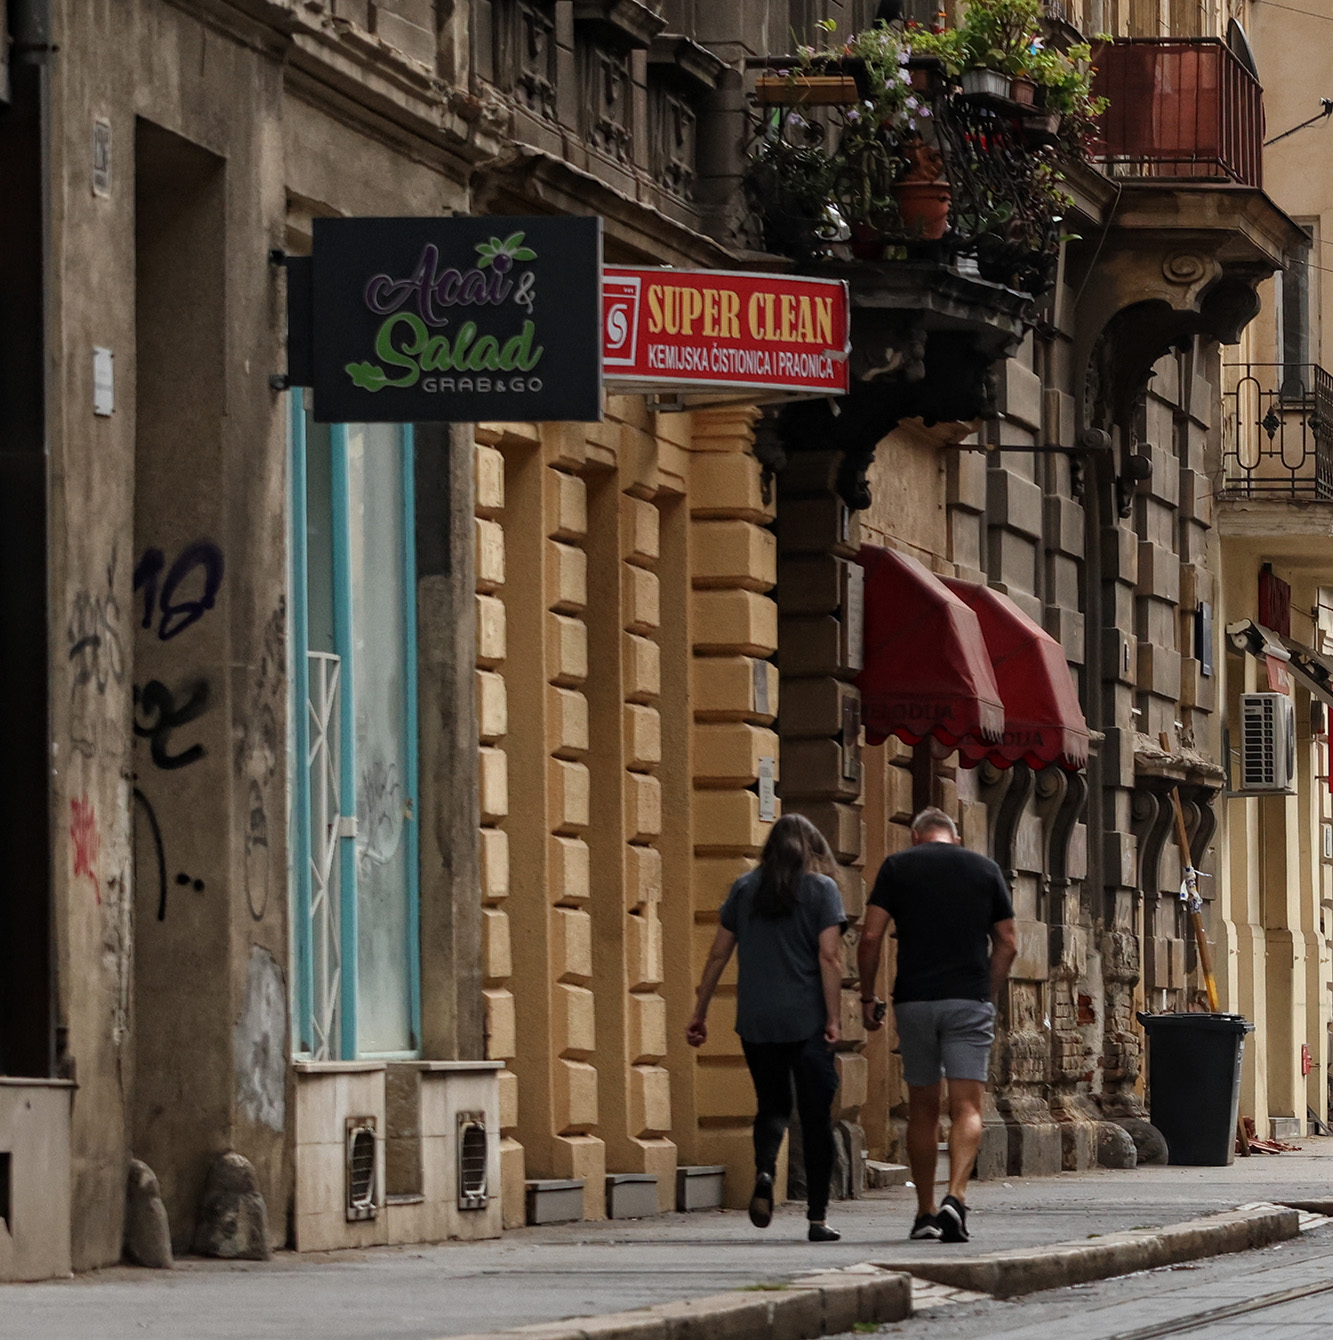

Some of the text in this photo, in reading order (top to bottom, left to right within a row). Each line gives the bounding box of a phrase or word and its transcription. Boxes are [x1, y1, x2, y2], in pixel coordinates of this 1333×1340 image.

[364, 242, 537, 327] Acai &
[648, 284, 833, 345] SUPER CLEAN
[374, 312, 544, 388] Salad
[648, 344, 709, 371] KEMIJSKA
[711, 341, 773, 376] ČISTIONICA
[778, 351, 835, 380] PRAONICA
